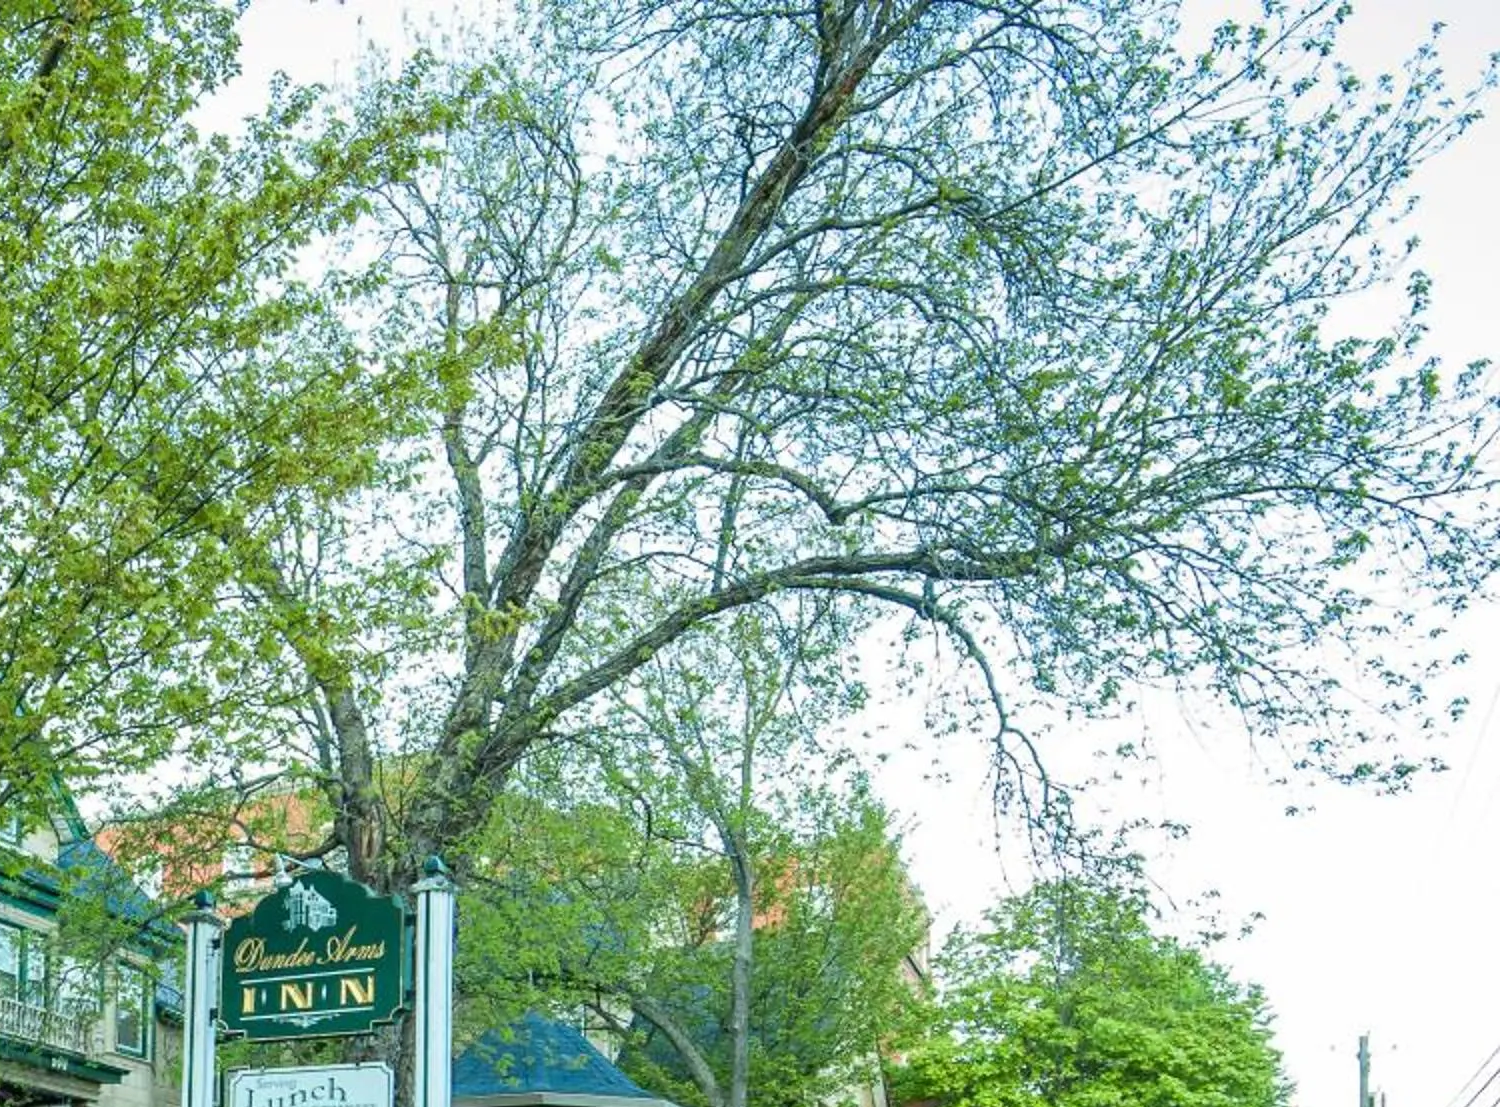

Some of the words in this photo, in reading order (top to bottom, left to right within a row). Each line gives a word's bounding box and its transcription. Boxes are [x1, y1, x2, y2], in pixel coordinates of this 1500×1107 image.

[233, 936, 316, 973] Dundee
[318, 924, 386, 965] Arms
[242, 974, 376, 1014] INN
